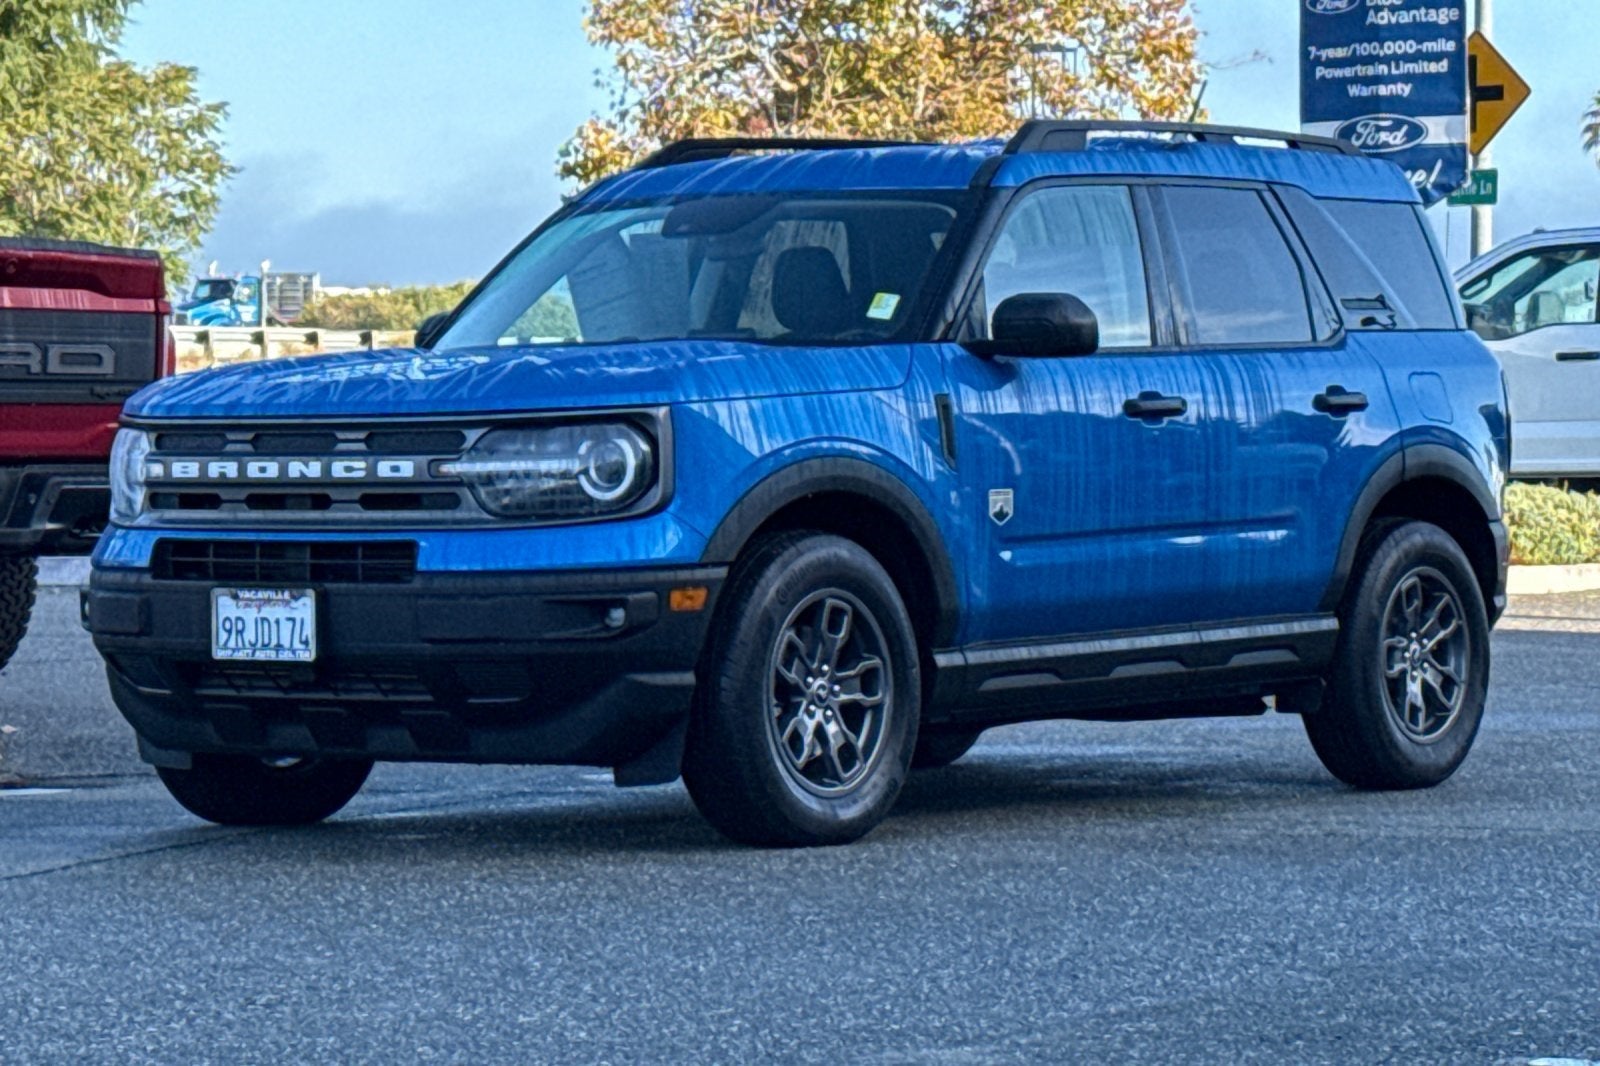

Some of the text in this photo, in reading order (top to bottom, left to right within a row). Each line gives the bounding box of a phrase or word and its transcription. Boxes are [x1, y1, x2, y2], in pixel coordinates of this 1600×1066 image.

[1365, 7, 1460, 25] Advantage
[1307, 38, 1456, 61] 7-year/100,000-mile
[1315, 58, 1449, 80] Powertrain Limited
[1347, 82, 1413, 97] Warranty
[1351, 119, 1409, 146] Ford
[171, 461, 414, 478] BRONCO
[222, 616, 309, 648] 9RJD174
